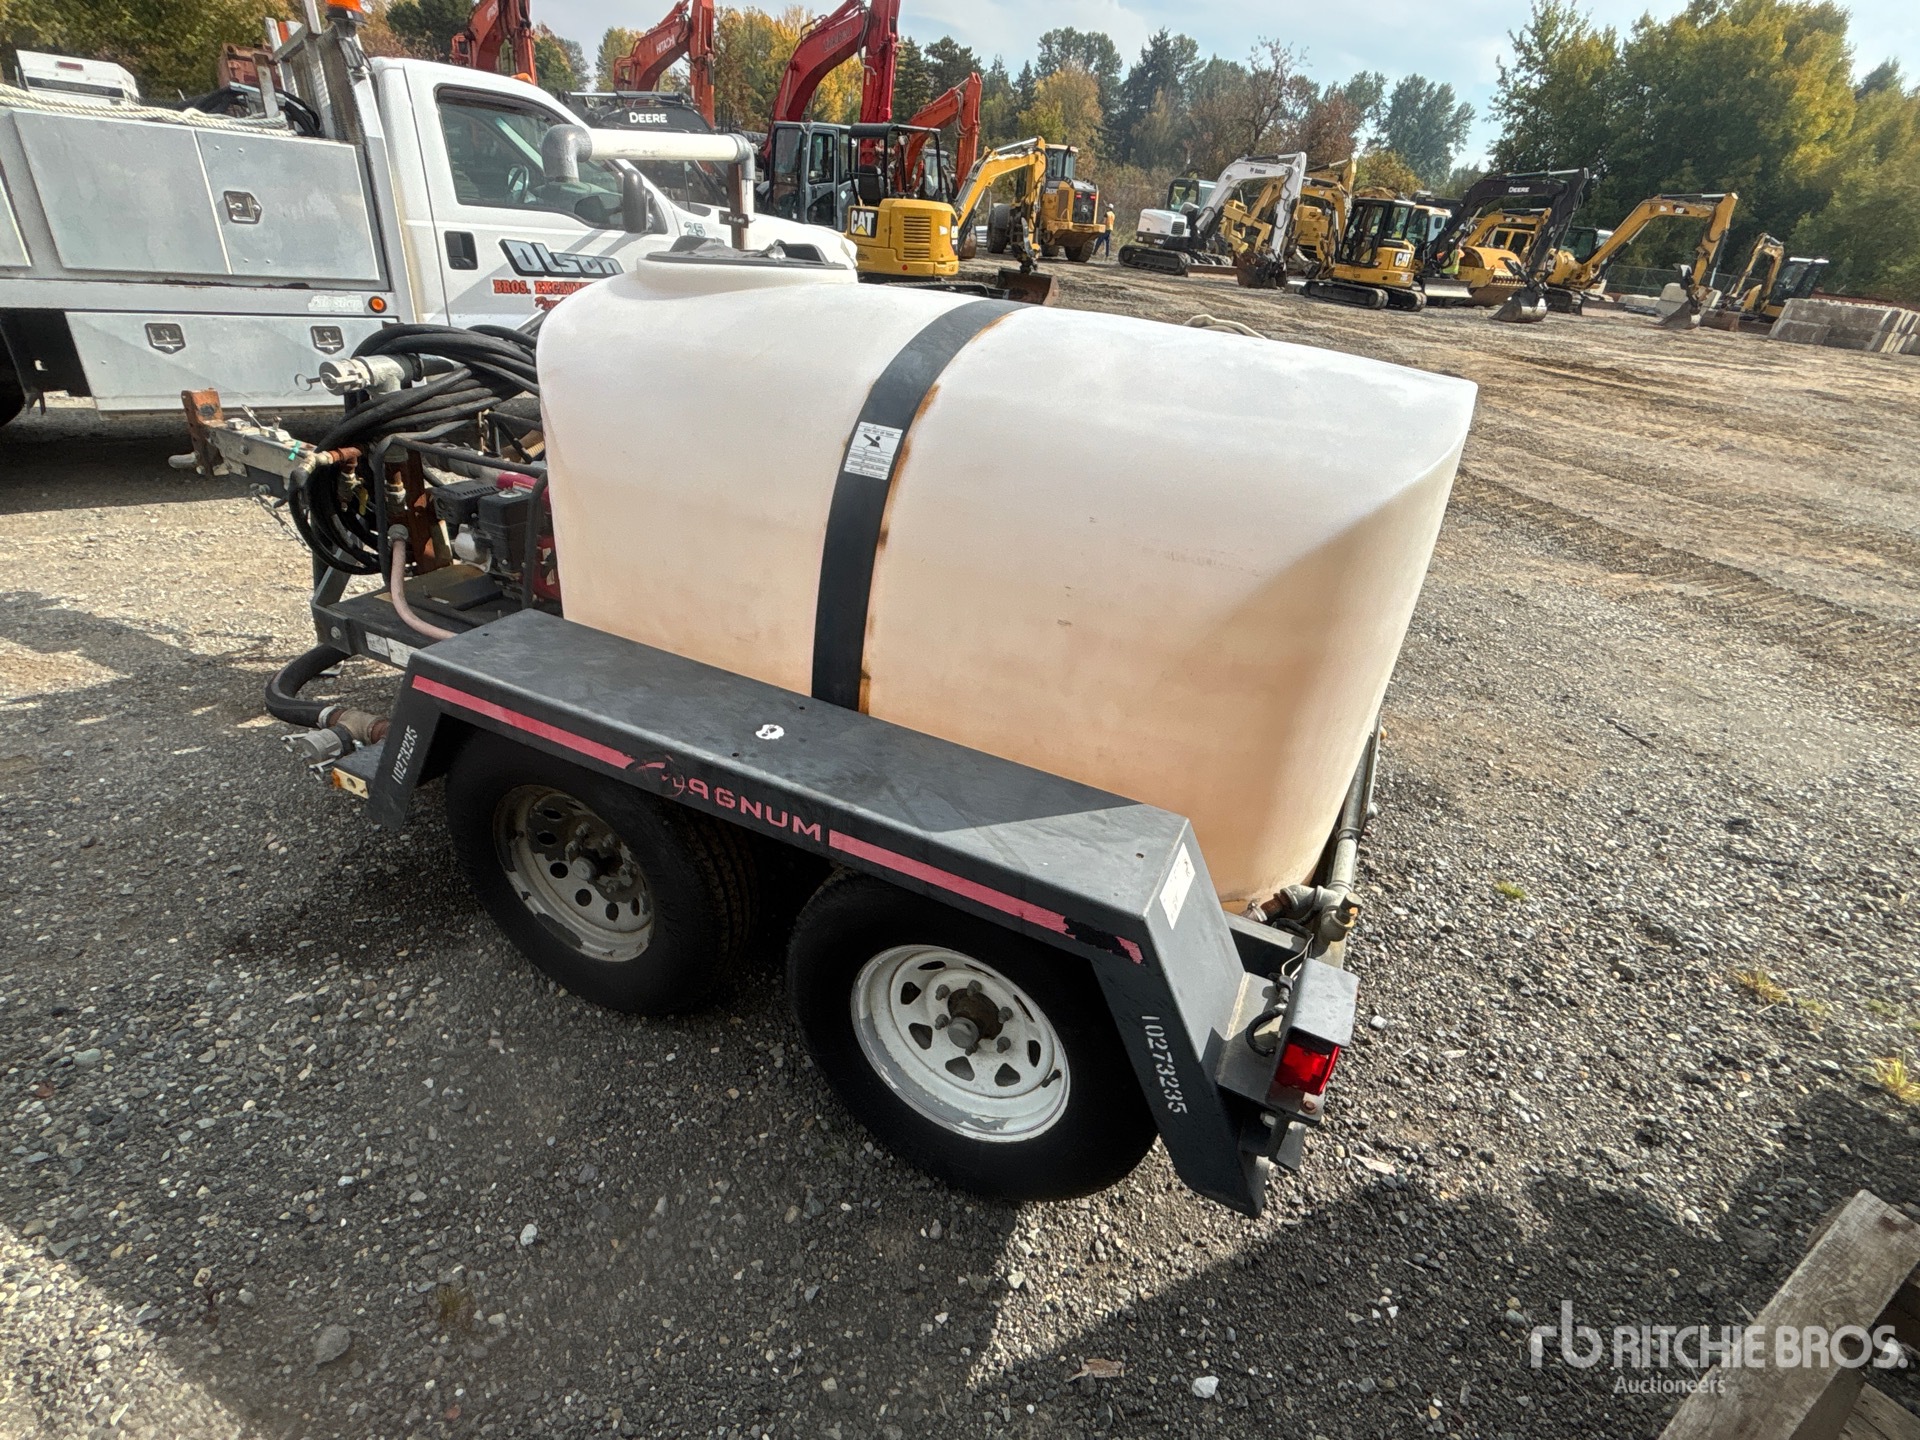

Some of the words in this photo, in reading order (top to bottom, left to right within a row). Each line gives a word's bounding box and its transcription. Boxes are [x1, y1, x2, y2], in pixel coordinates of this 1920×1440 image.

[656, 34, 676, 55] HITACHI
[629, 111, 668, 124] DEERE
[683, 221, 706, 238] 25
[850, 209, 875, 236] CAT
[1394, 252, 1411, 267] CAT
[493, 280, 531, 294] BROS.
[391, 725, 418, 785] 10273235
[1141, 1015, 1188, 1114] 10273235
